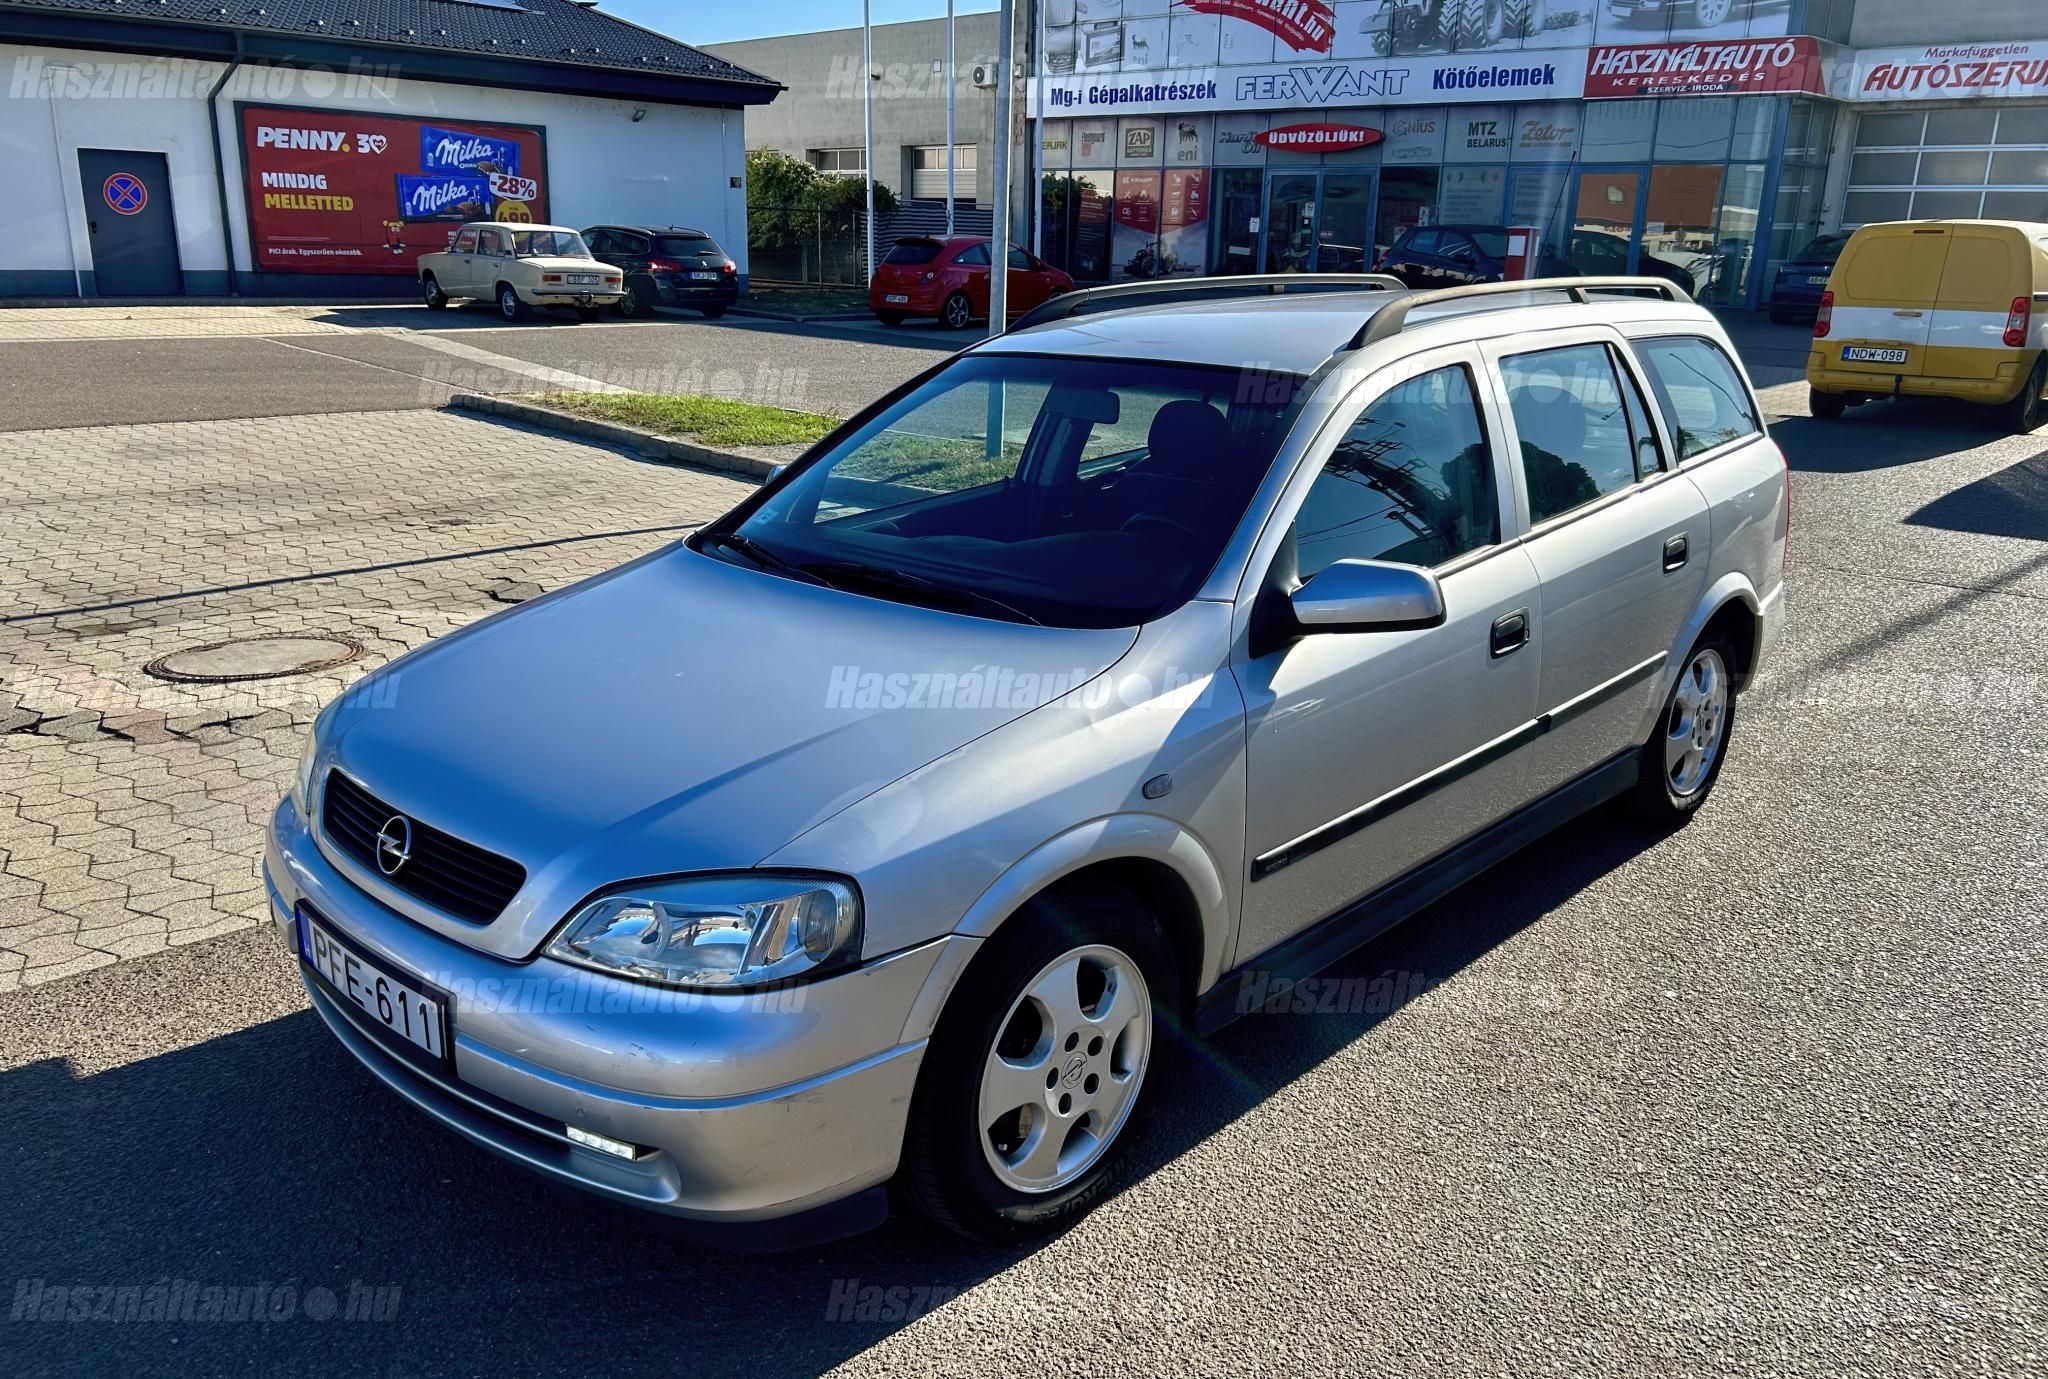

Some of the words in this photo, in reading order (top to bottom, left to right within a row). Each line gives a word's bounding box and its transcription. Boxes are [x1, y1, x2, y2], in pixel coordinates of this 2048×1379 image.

[1590, 38, 1796, 76] HASZNÁLTAUTÓ
[1924, 44, 2029, 59] Márkafüggetlen
[1612, 71, 1767, 87] KERESKEDÉS
[1863, 59, 2048, 92] AUTÓSZERV
[1050, 88, 1082, 107] Mg-i
[1089, 80, 1217, 105] Gépalkatrészek
[1433, 64, 1555, 90] Kötőelemek
[1647, 84, 1724, 94] SZERVIZ-IRODA
[1468, 122, 1498, 136] MTZ
[1128, 131, 1151, 146] ZAP
[1269, 131, 1365, 145] ÜDVÖZÖLJÜK!
[1467, 138, 1507, 148] BELARUS
[435, 138, 494, 166] Milka
[1177, 146, 1198, 161] eni
[262, 172, 327, 189] MINDIG
[490, 175, 535, 198] -28%
[264, 193, 354, 211] MELLETTED
[412, 180, 469, 212] Milka
[1850, 349, 1903, 361] NDW-098
[312, 926, 432, 1051] PFE-611
